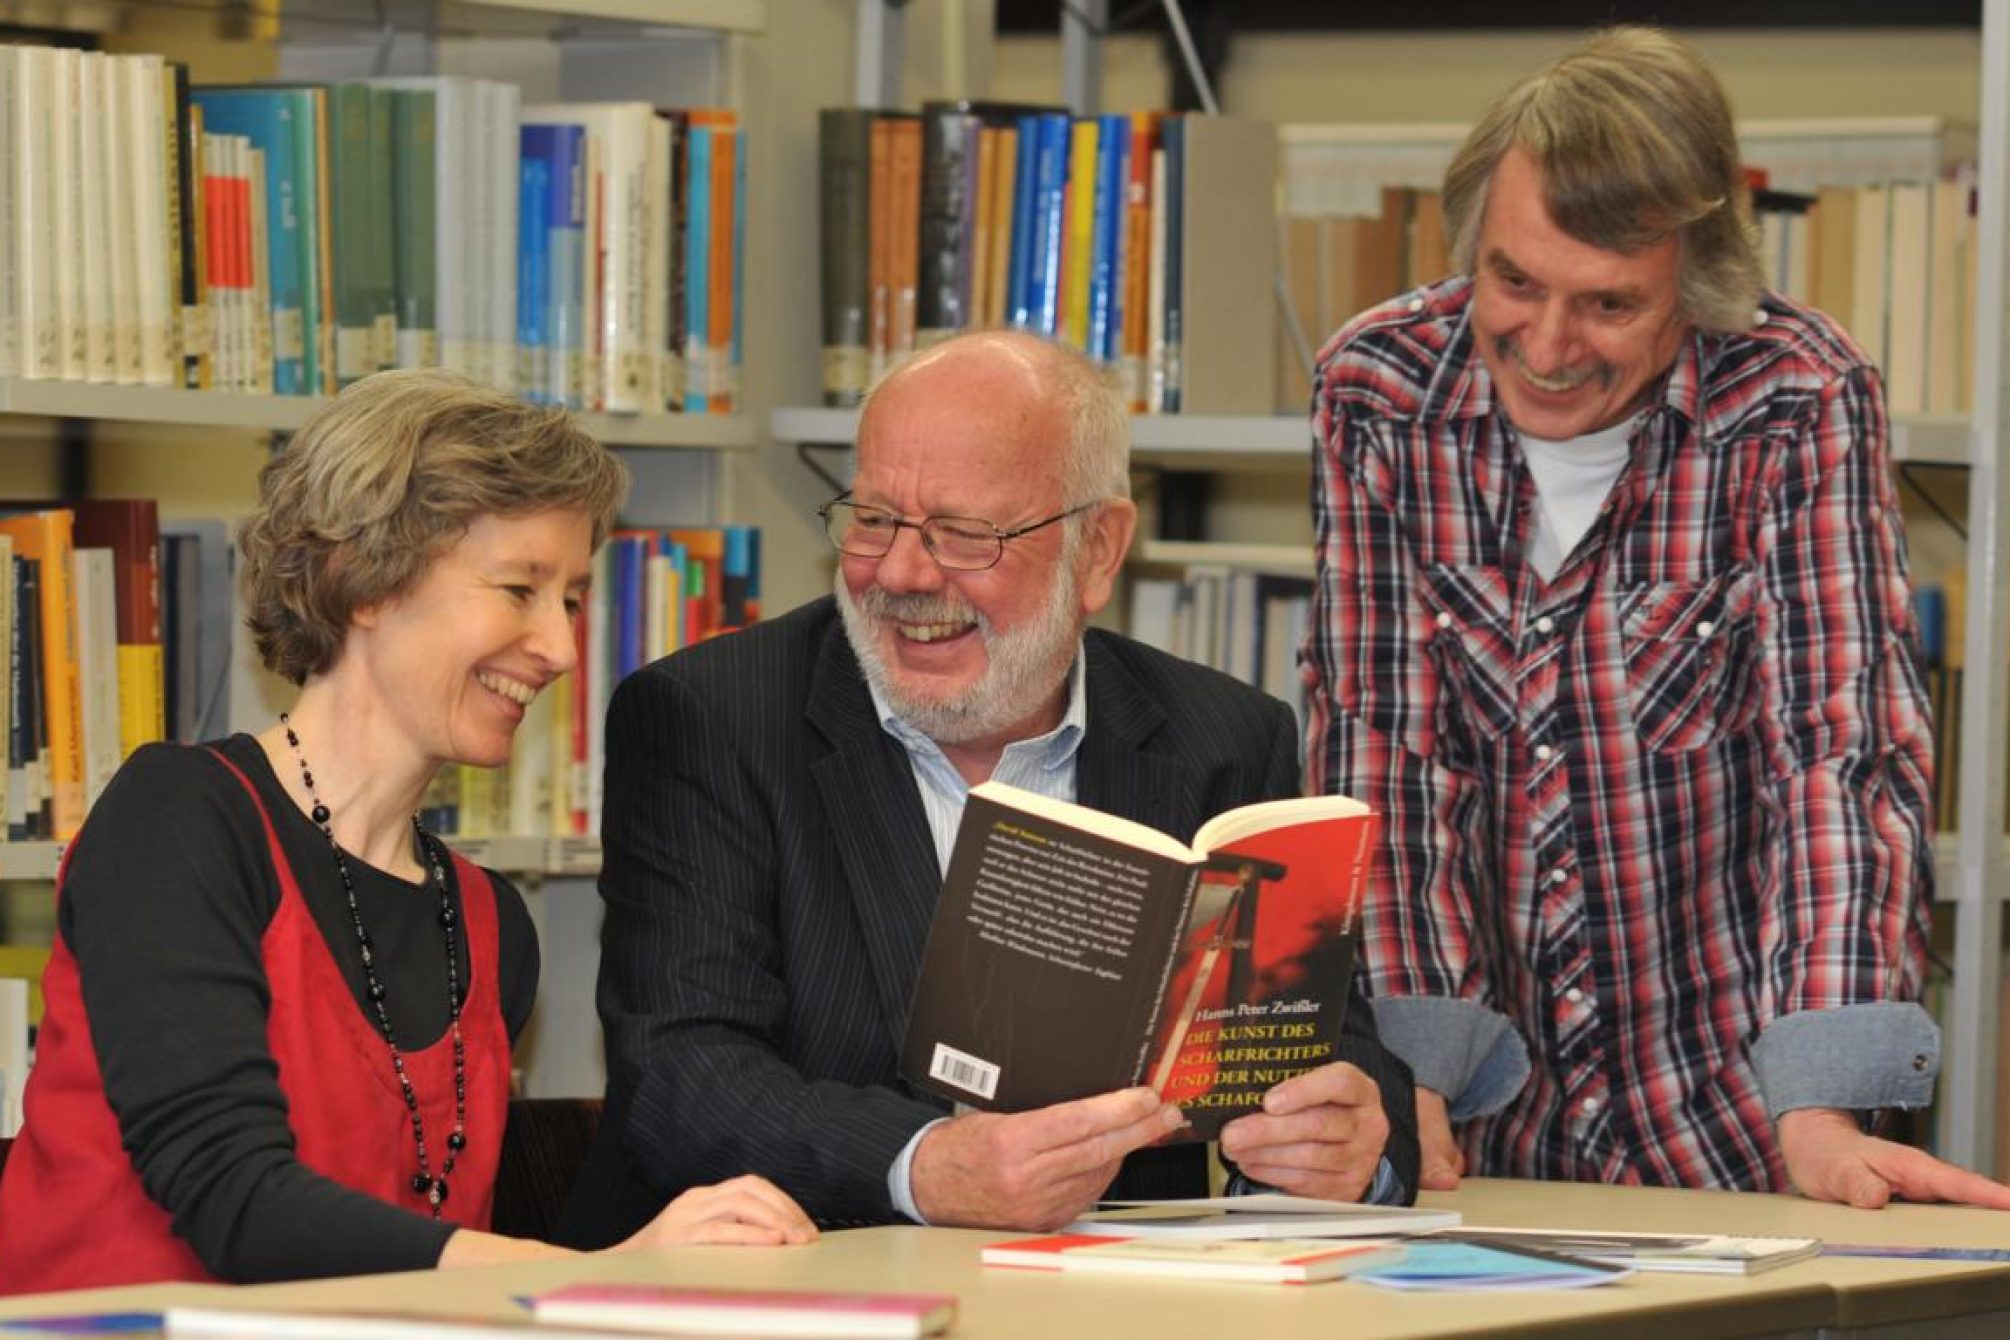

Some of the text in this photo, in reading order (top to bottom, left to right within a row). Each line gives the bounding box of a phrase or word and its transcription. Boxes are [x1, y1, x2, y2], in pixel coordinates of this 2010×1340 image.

[1238, 1003, 1269, 1015] Peter
[1187, 1022, 1316, 1045] DIE KUNST DES
[1181, 1044, 1331, 1065] SCHARFRICHTERS
[1171, 1073, 1210, 1089] UND
[1214, 1069, 1249, 1085] DER
